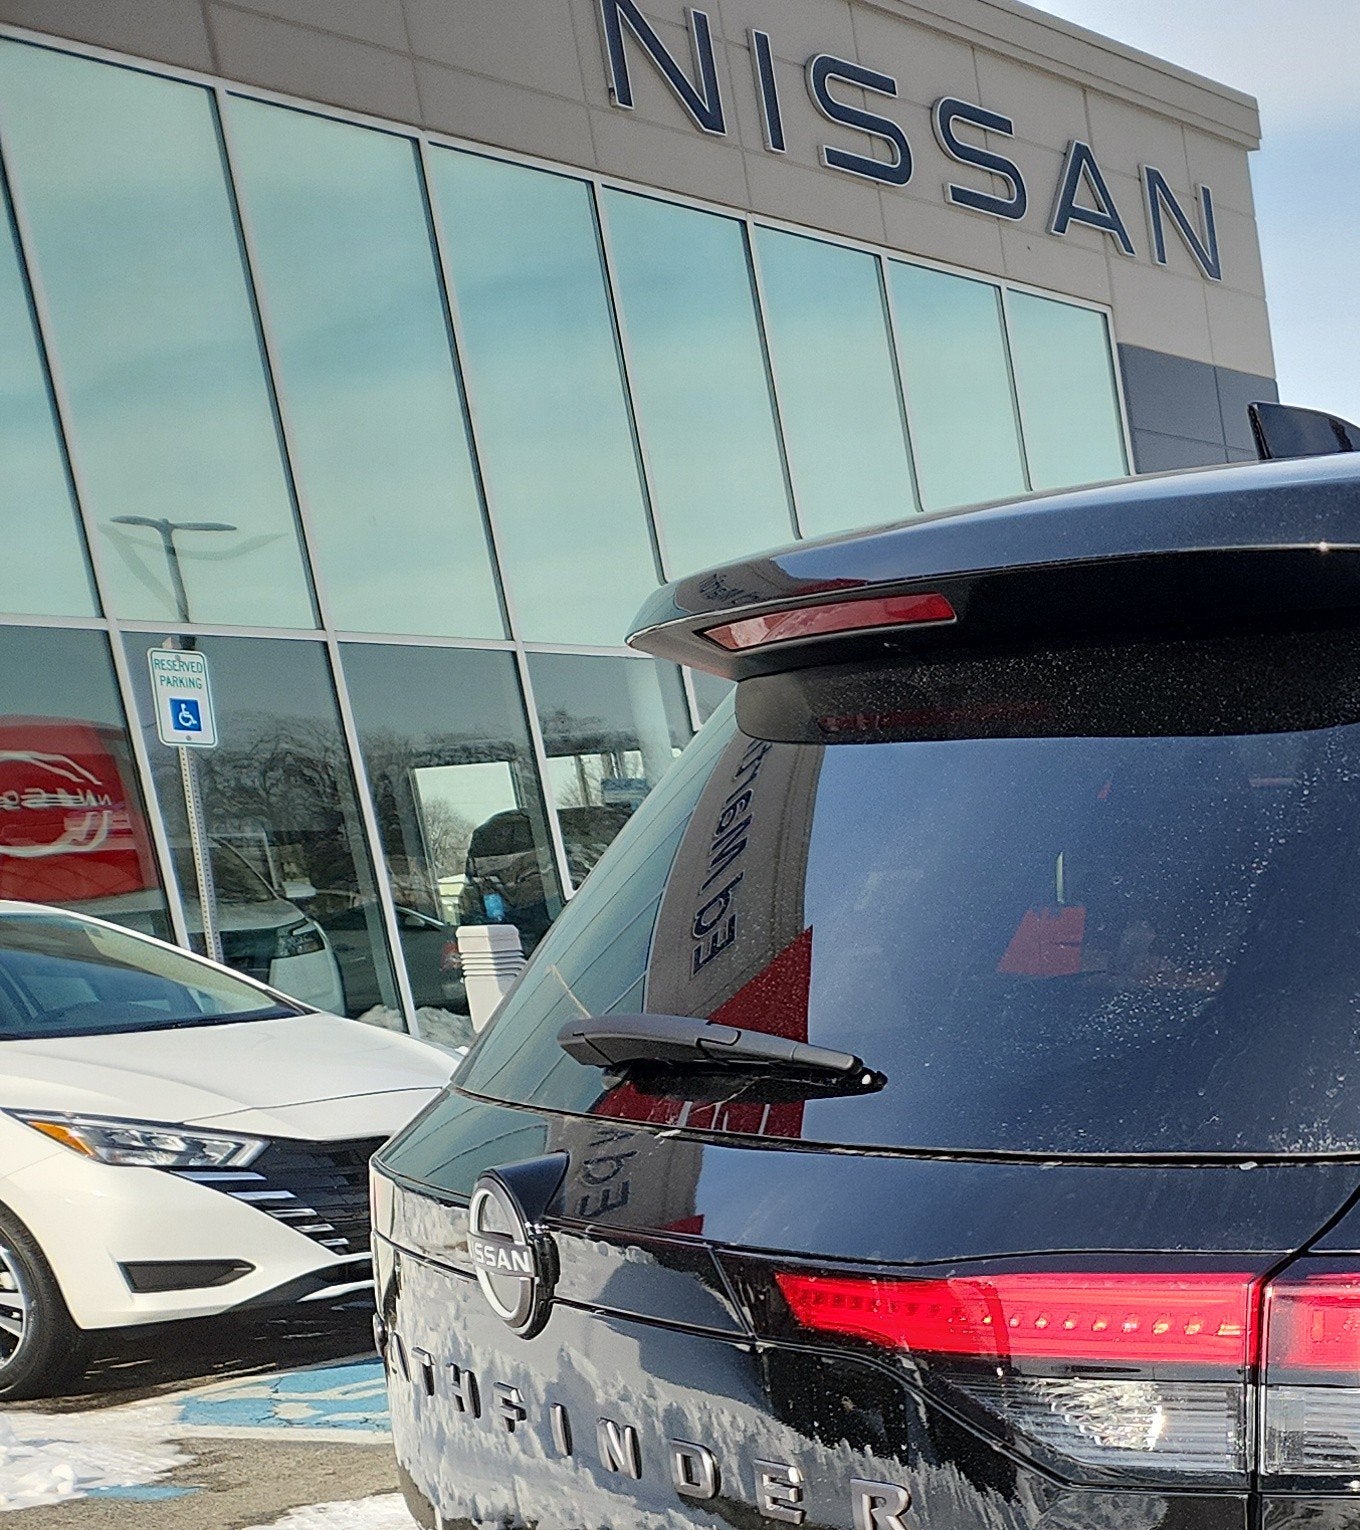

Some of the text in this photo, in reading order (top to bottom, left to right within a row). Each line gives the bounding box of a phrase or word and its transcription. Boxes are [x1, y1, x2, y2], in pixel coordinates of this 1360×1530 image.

[602, 0, 1223, 283] NISSAN
[153, 658, 203, 673] RESERVED
[160, 675, 202, 690] PARKING
[473, 1241, 531, 1273] SSAN
